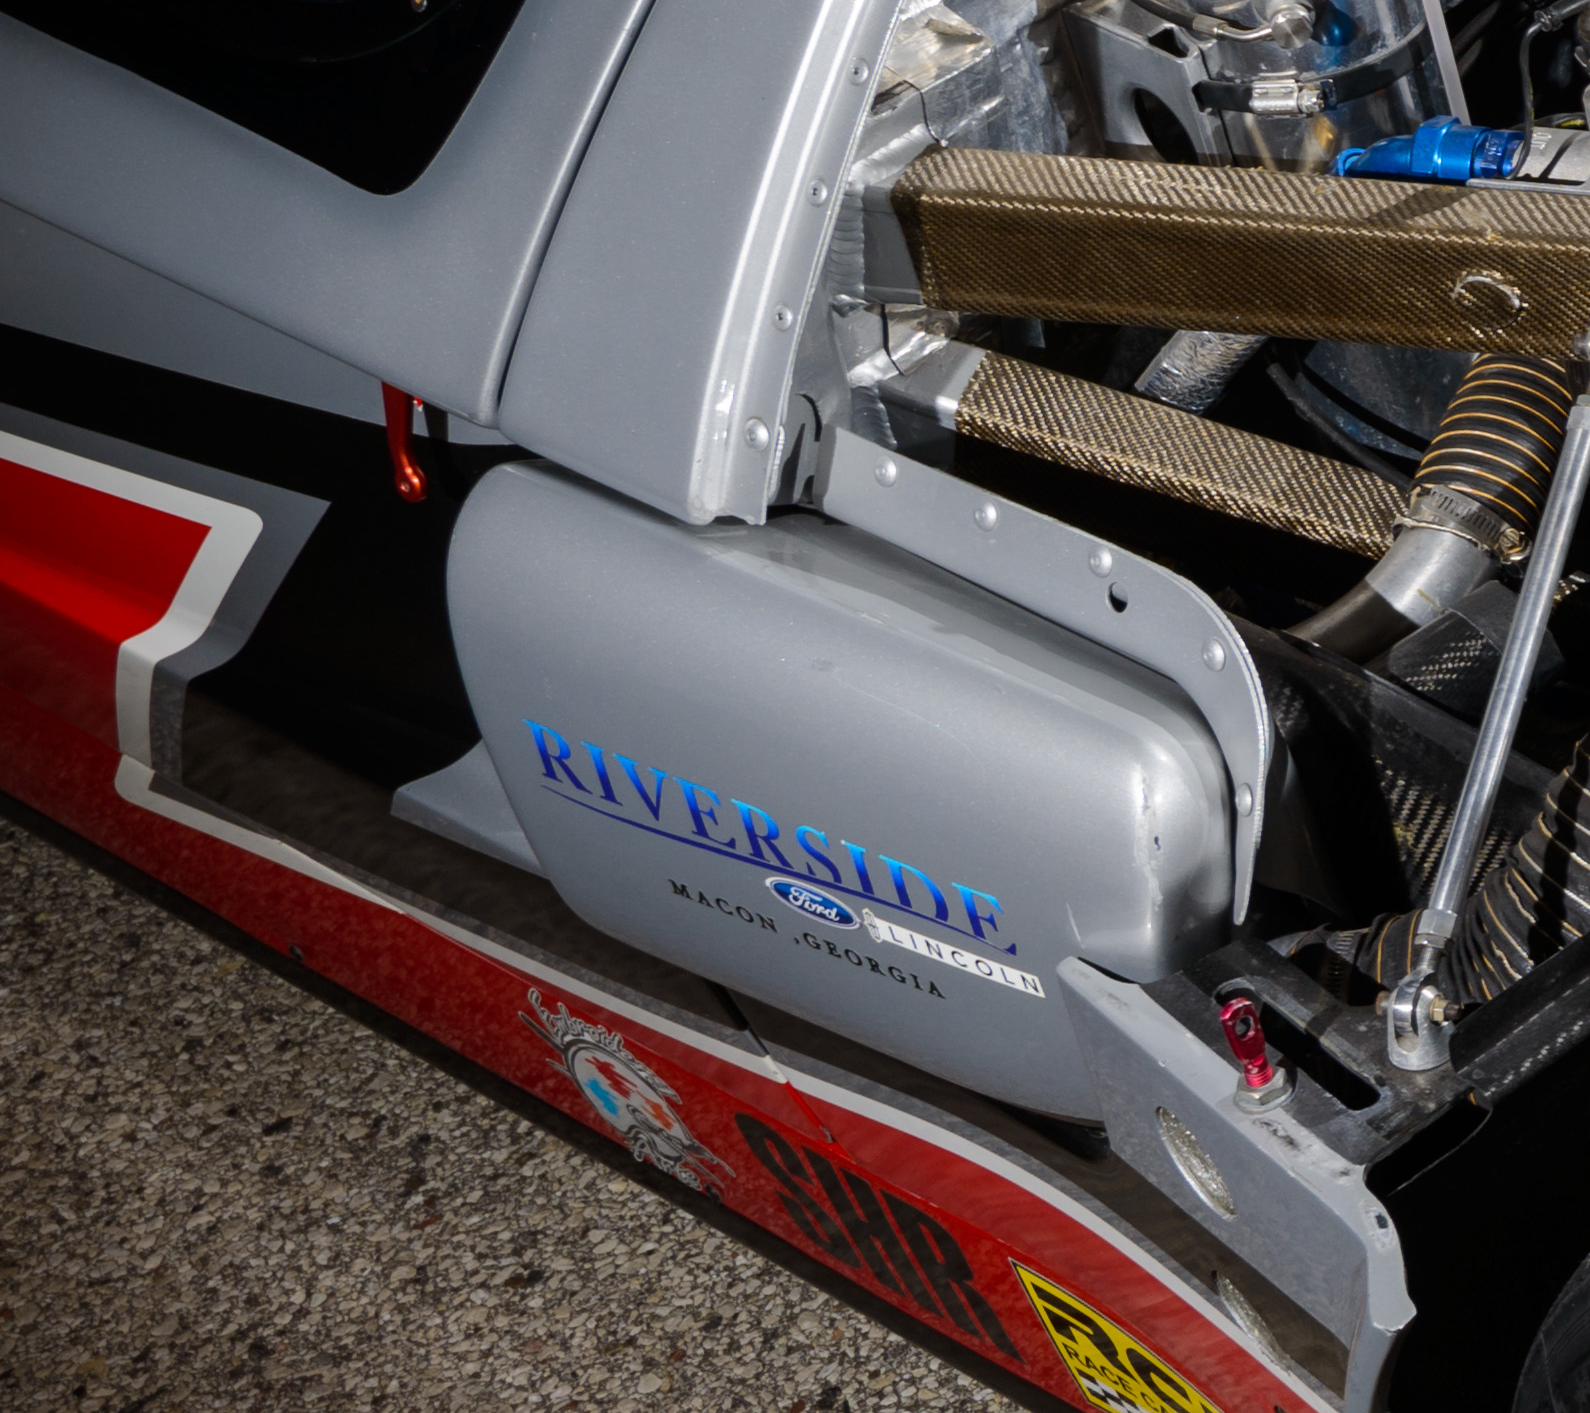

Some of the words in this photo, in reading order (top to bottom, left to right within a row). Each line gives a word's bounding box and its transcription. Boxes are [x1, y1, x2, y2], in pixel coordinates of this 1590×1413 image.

[523, 718, 1018, 957] RIVERSIDE
[667, 878, 778, 934] MACON
[787, 885, 841, 923] Ford
[889, 926, 1041, 995] LINCOLN
[735, 1110, 1026, 1364] SHR
[1060, 1341, 1139, 1399] RACE
